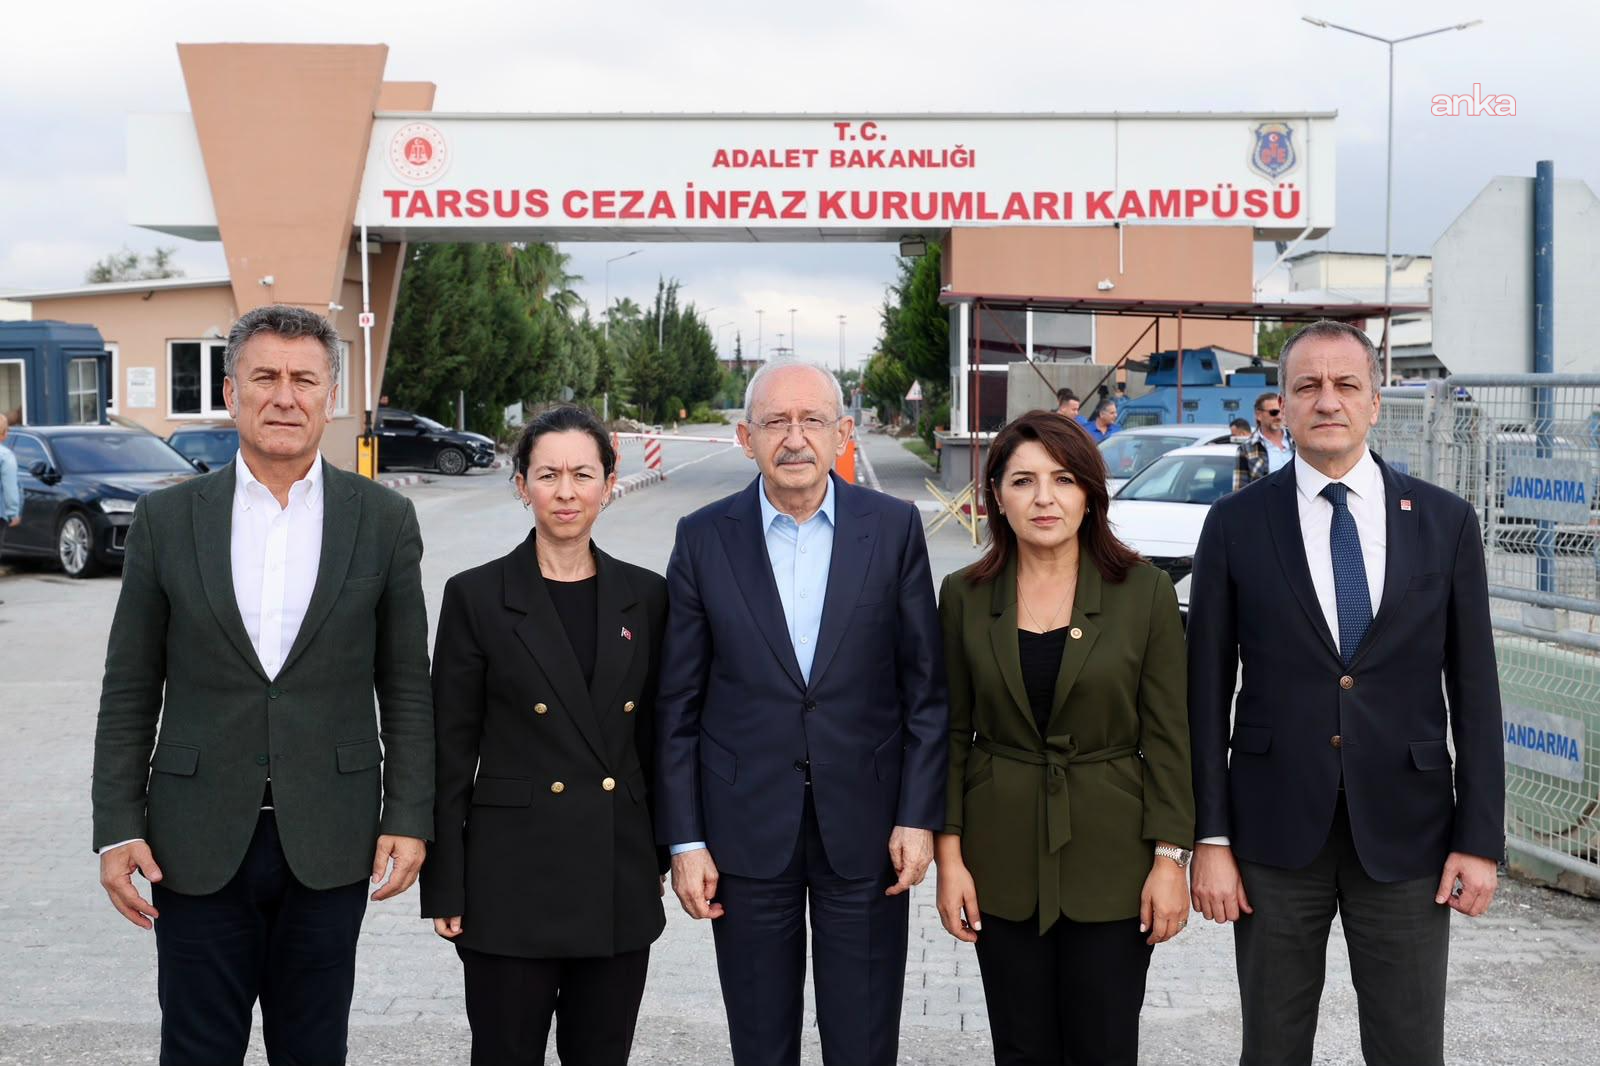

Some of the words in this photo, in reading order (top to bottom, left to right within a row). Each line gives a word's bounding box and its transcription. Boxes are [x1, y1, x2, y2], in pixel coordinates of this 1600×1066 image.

[834, 121, 888, 142] T.C.
[712, 148, 820, 169] ADALET
[830, 144, 976, 169] BAKANLIĞI
[383, 188, 551, 220] TARSUS
[562, 189, 677, 220] CEZA
[686, 181, 809, 220] İNFAZ
[818, 190, 1074, 222] KURUMLARI
[1086, 182, 1302, 221] KAMPÜSÜ
[1507, 476, 1585, 504] JANDARMA
